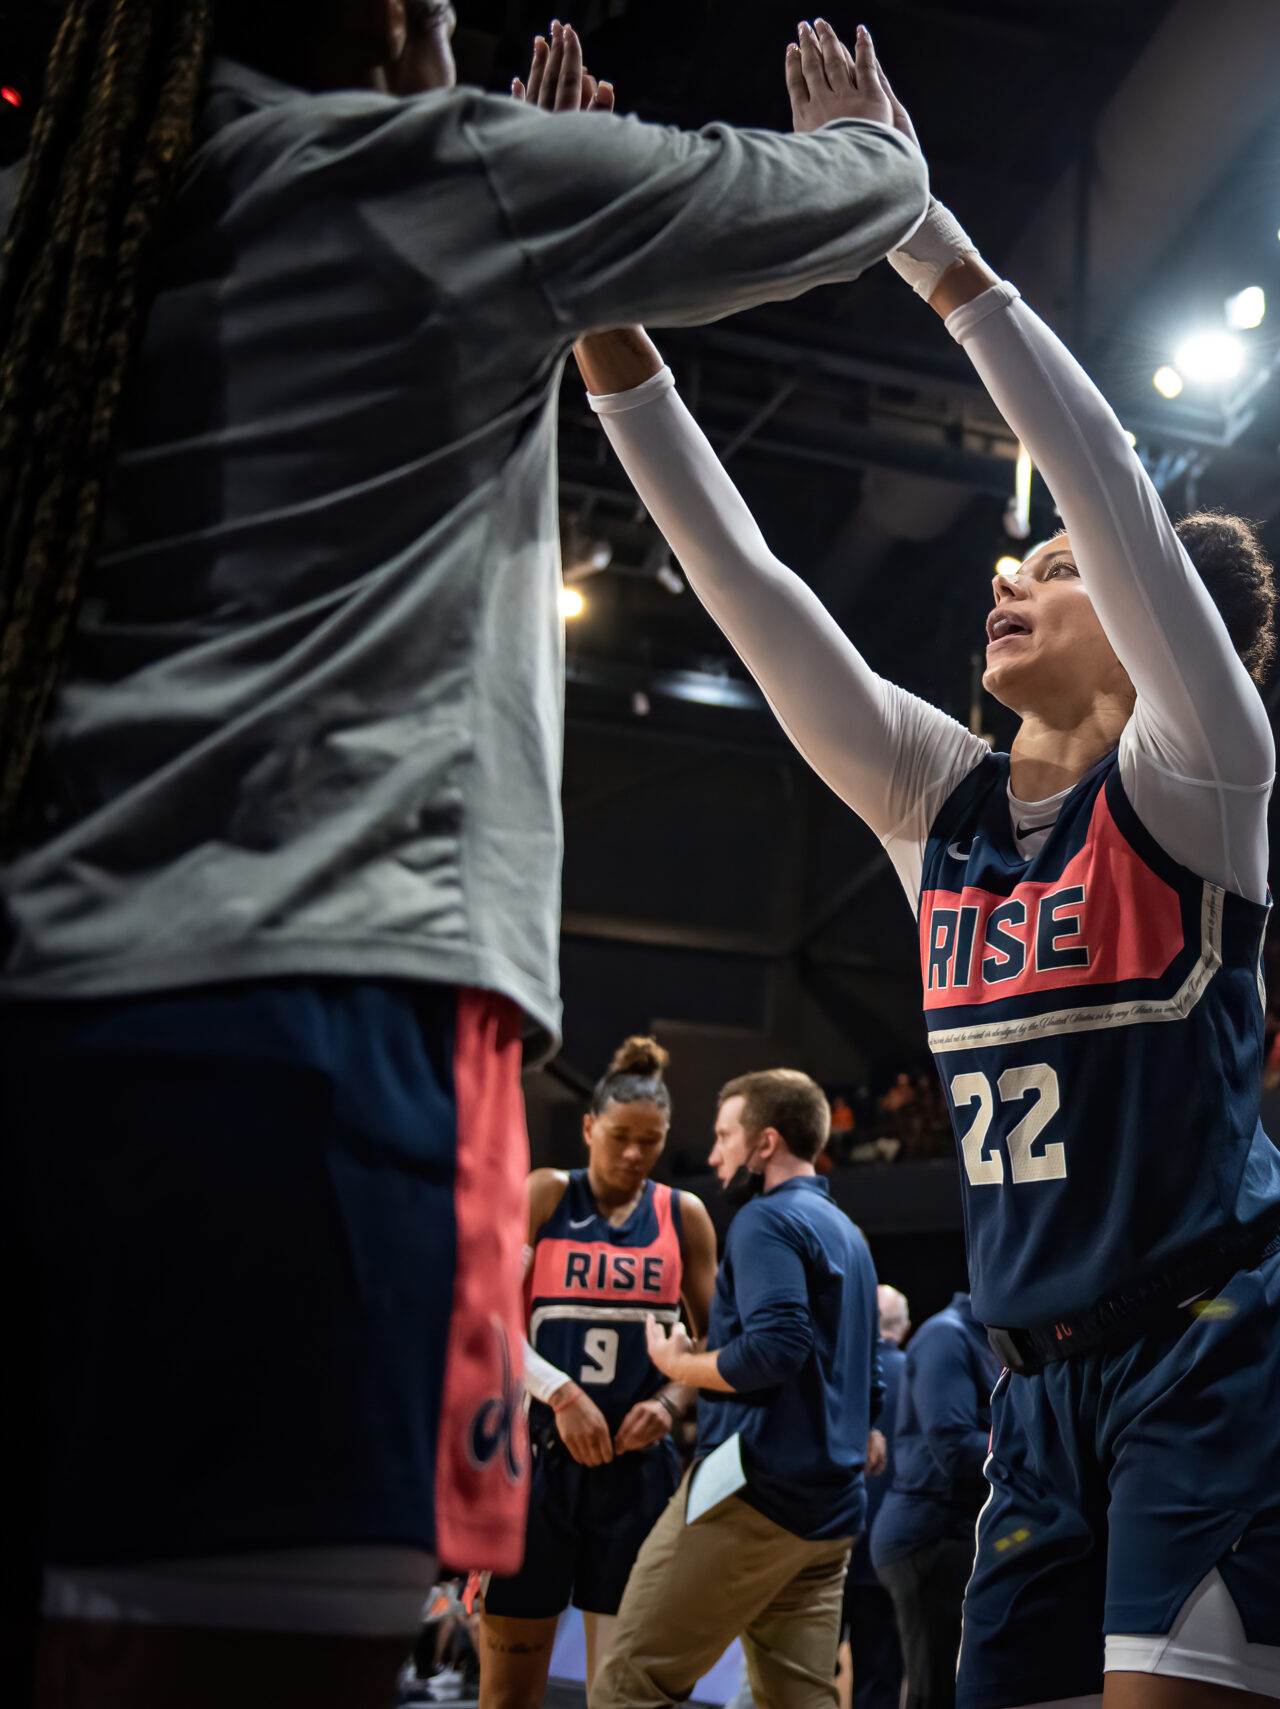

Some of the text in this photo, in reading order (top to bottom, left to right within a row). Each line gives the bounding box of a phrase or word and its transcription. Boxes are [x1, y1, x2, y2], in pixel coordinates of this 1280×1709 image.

[927, 884, 1090, 991] RISE
[950, 1062, 1067, 1186] 22
[564, 1250, 664, 1292] RISE
[580, 1327, 619, 1384] 9
